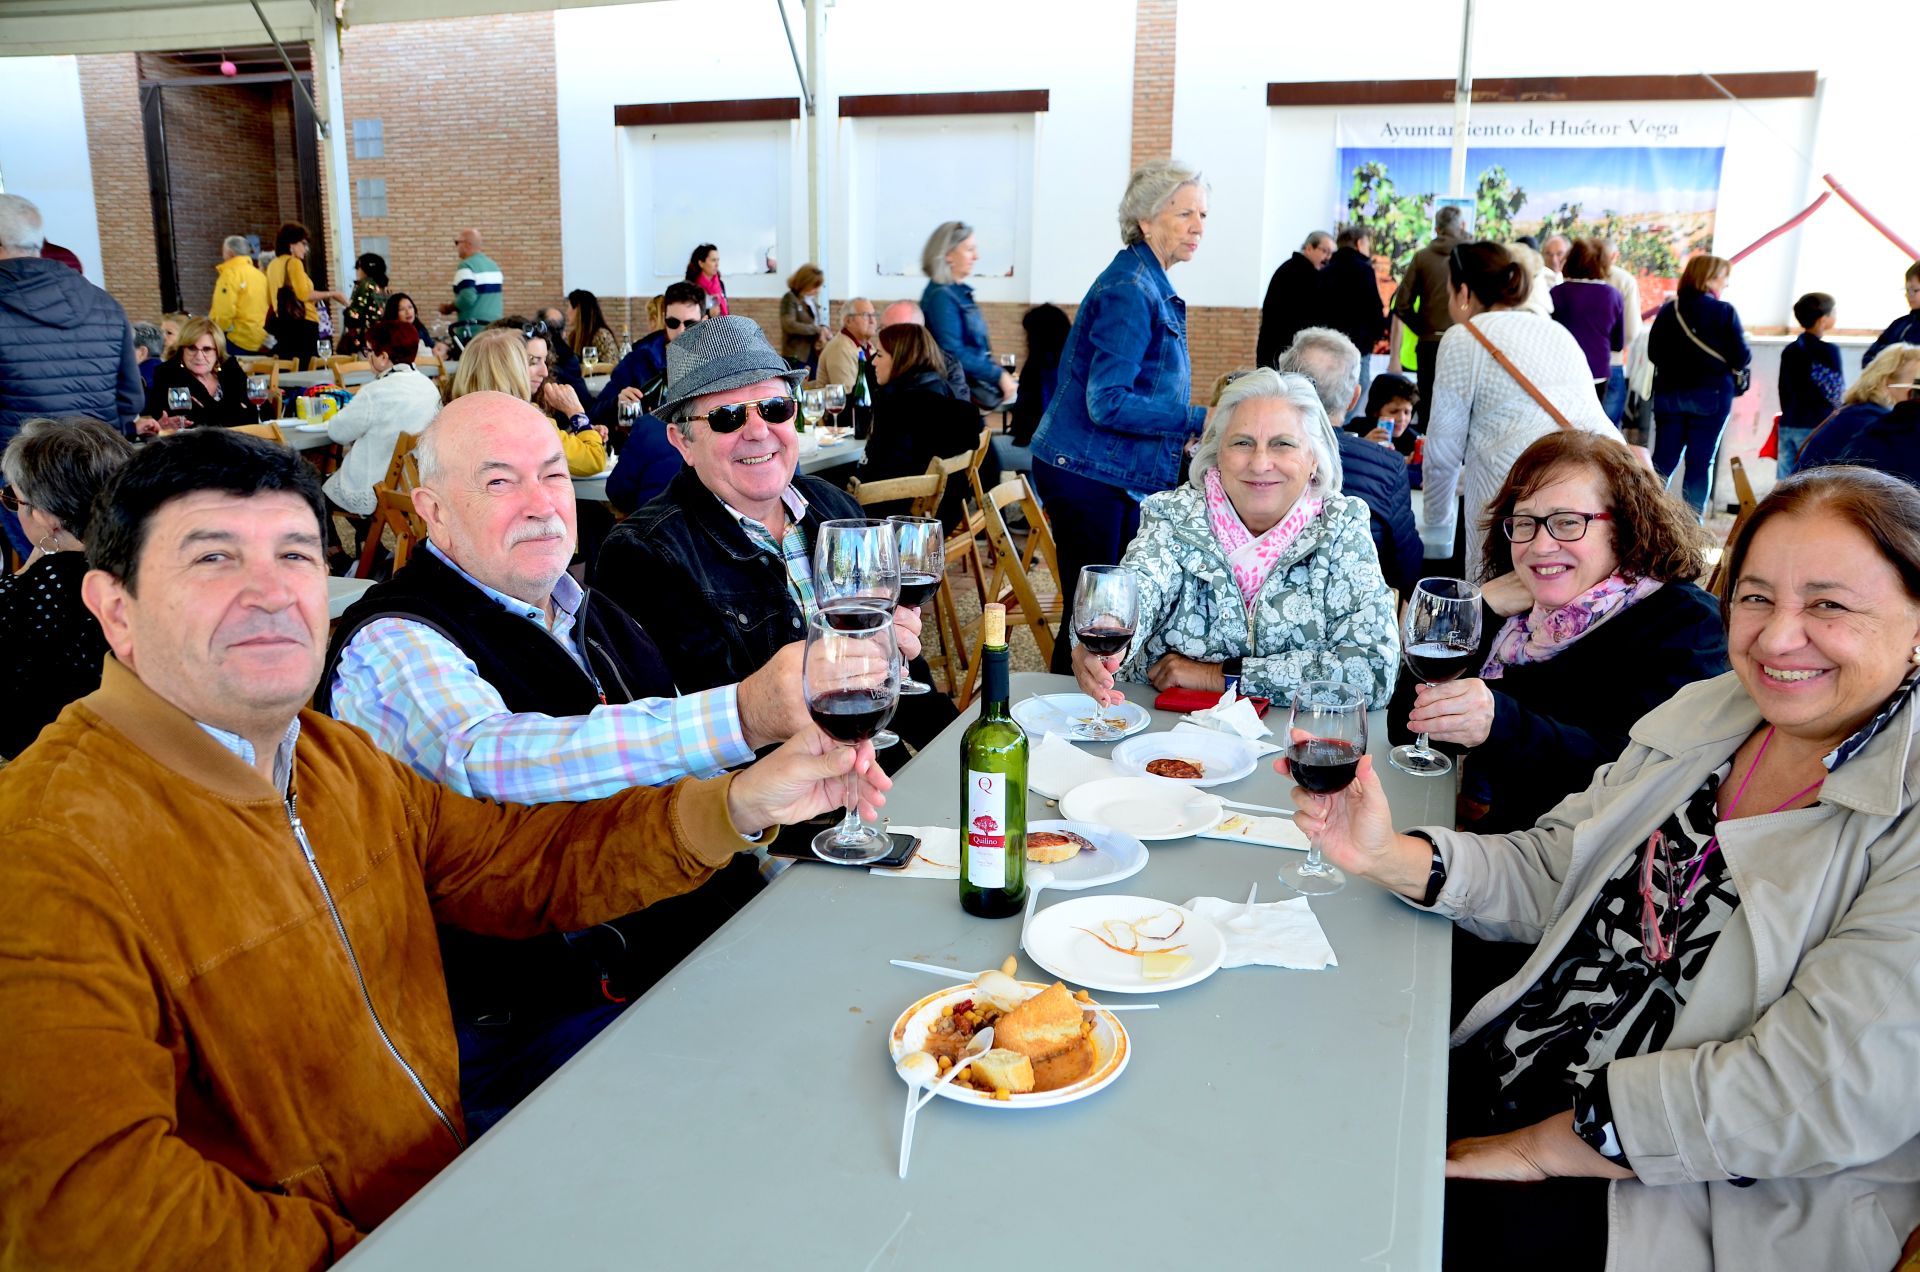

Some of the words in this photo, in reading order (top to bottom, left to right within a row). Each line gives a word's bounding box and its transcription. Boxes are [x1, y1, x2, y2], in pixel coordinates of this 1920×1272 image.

[1381, 120, 1515, 143] Ayuntaiento
[1521, 118, 1544, 136] de
[1550, 118, 1621, 136] Huétor
[1628, 118, 1679, 143] Vega
[973, 835, 998, 846] Quilino
